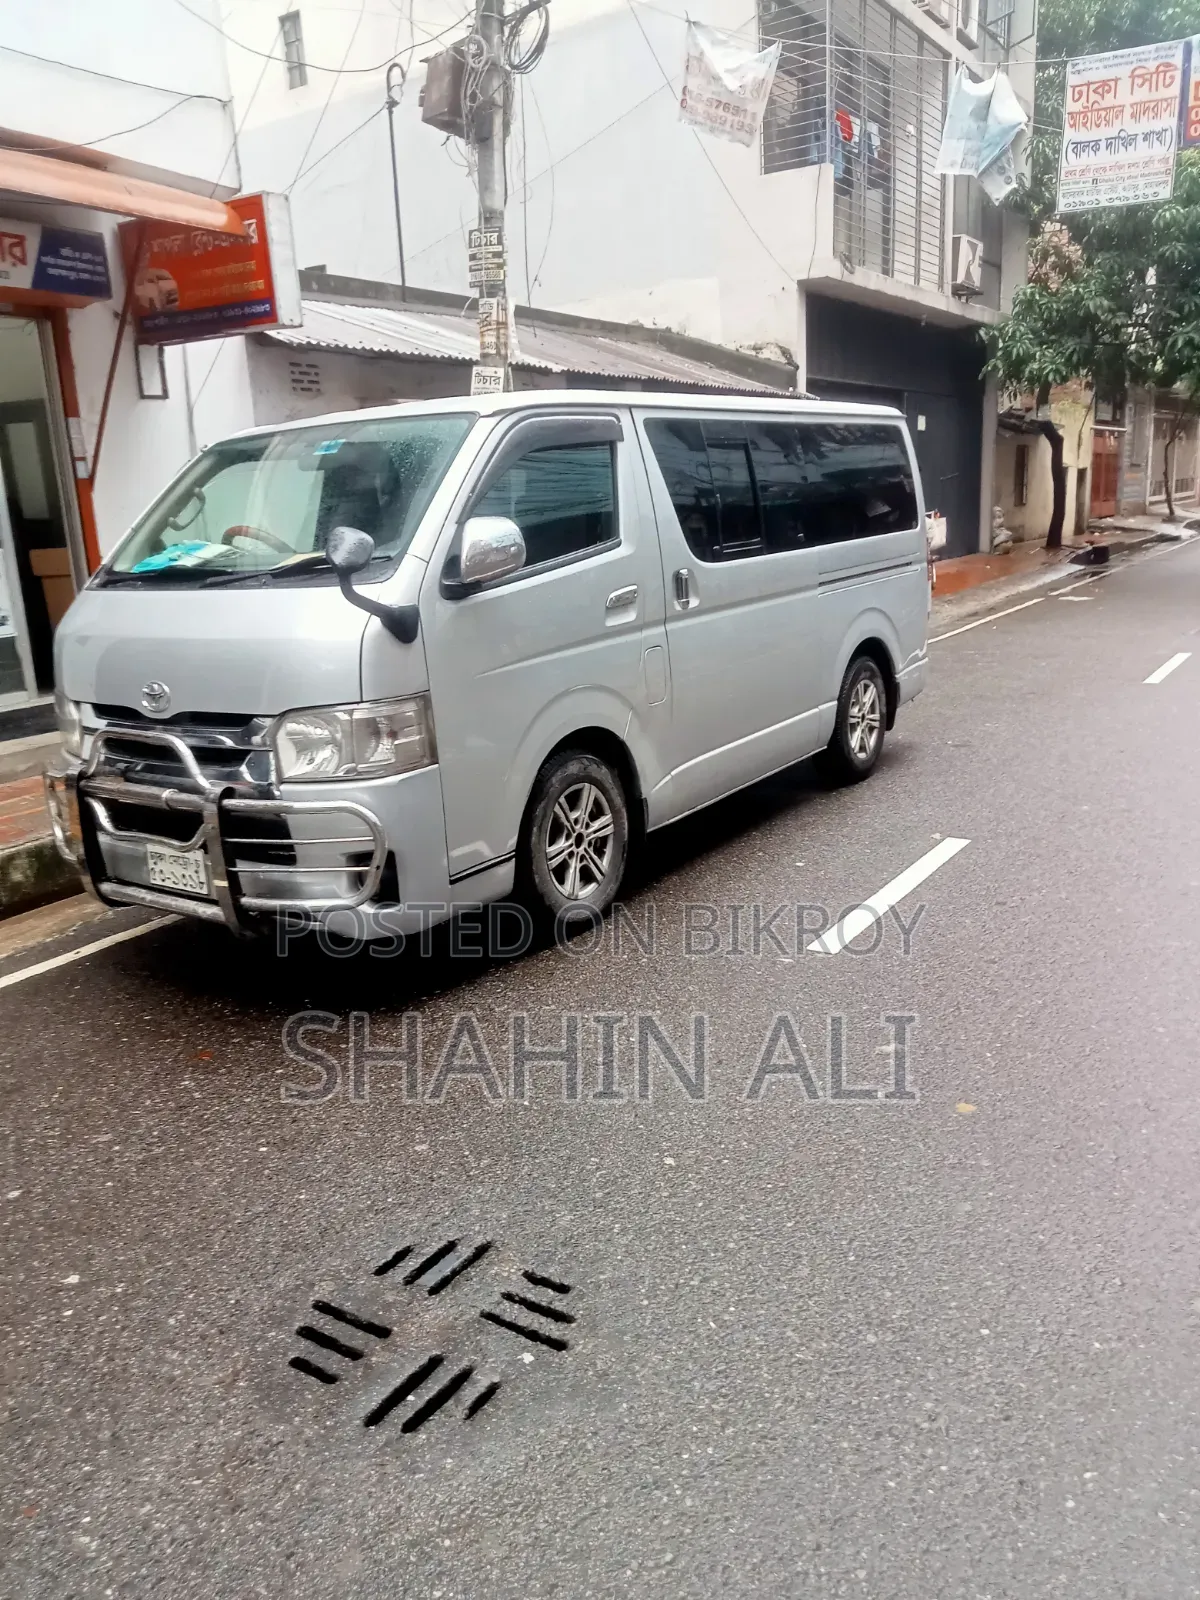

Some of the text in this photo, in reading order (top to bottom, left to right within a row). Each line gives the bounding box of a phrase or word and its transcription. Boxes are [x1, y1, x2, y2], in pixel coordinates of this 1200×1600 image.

[1070, 76, 1121, 104] ঢাকা
[1128, 62, 1180, 96] সিটি
[1067, 100, 1126, 133] আইডিয়াল
[1130, 96, 1178, 126] মাদরাসা
[1065, 125, 1173, 165] (বালক দাখিল শাখা)
[474, 371, 502, 386] টিচার
